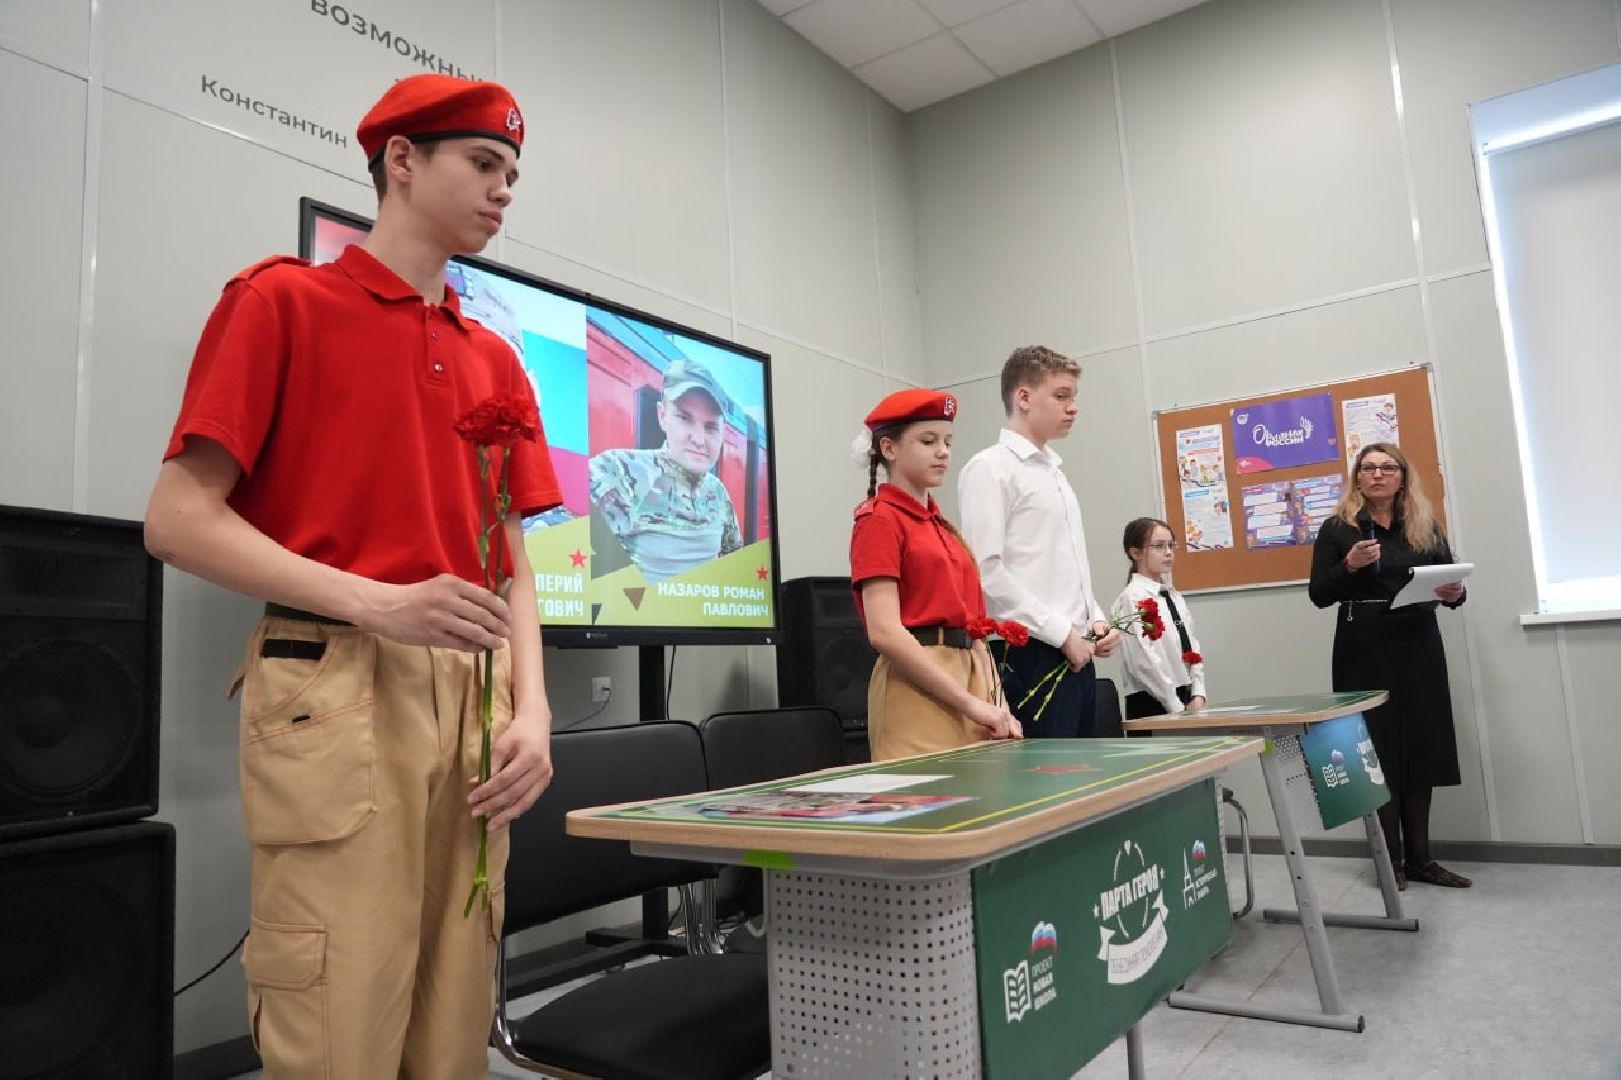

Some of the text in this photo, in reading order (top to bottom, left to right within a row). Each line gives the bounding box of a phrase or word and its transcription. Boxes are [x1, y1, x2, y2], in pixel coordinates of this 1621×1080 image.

[201, 74, 347, 149] Константин
[658, 582, 765, 600] НАЗАРОВ РОМАН
[537, 597, 584, 617] ГОВИЧ
[703, 601, 769, 616] ПАВЛОВИЧ
[1100, 881, 1133, 921] ПАРТА
[1132, 863, 1159, 901] ГЕРОЯ
